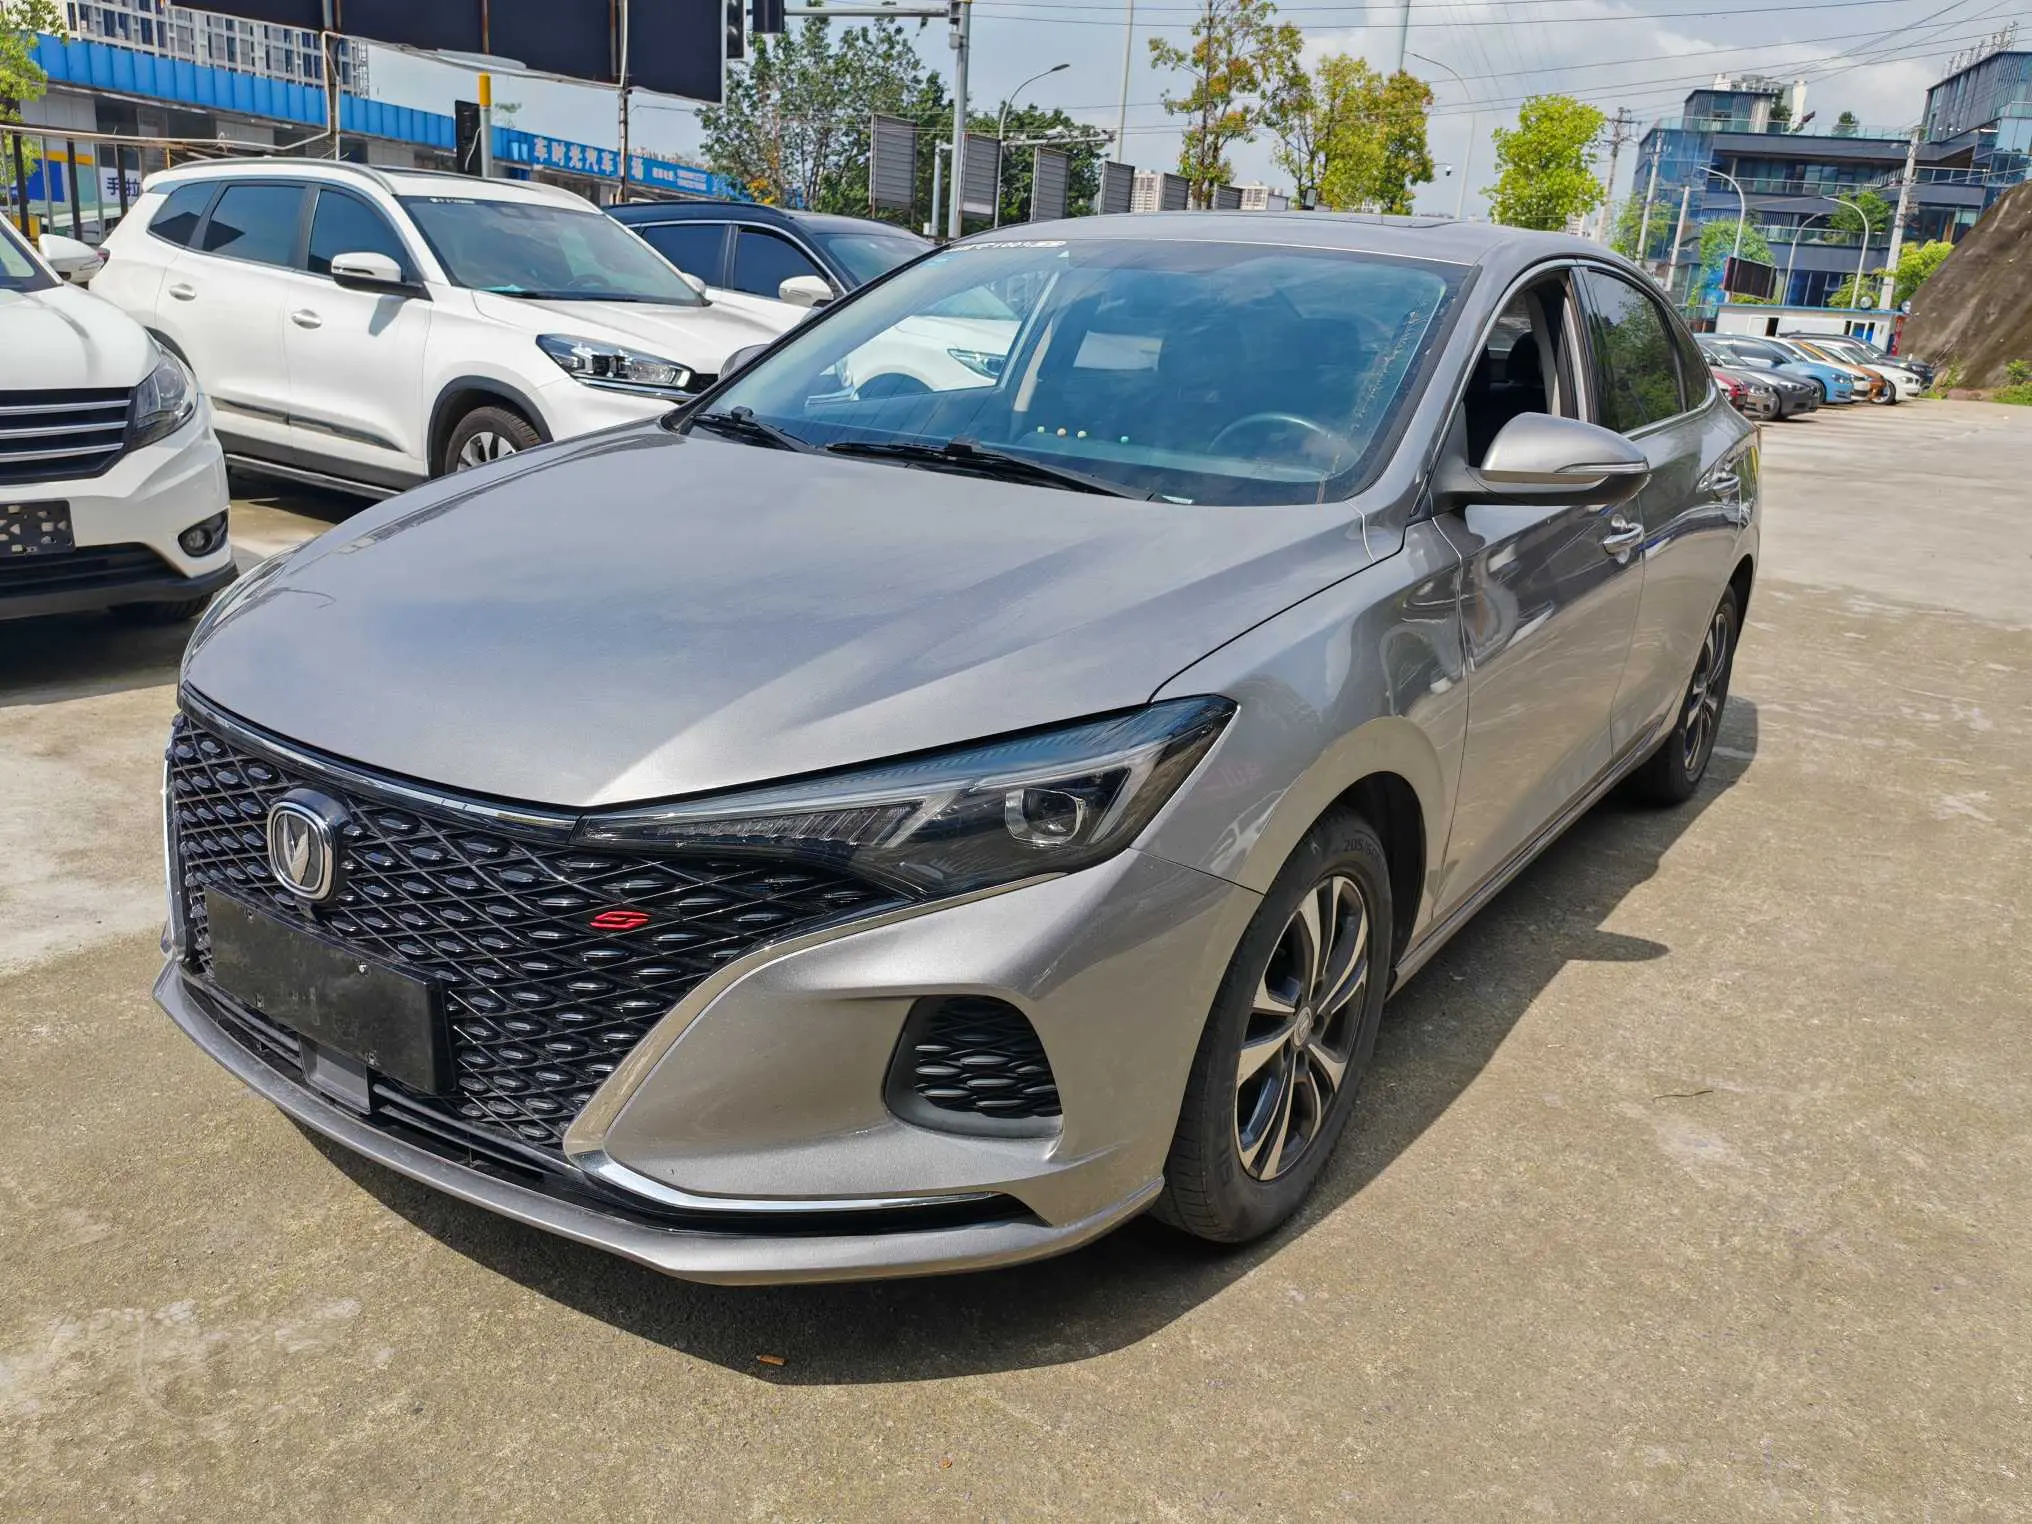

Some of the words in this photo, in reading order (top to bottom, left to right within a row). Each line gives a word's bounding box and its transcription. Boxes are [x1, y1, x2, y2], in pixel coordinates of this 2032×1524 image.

[534, 136, 644, 180] 车时光汽车场
